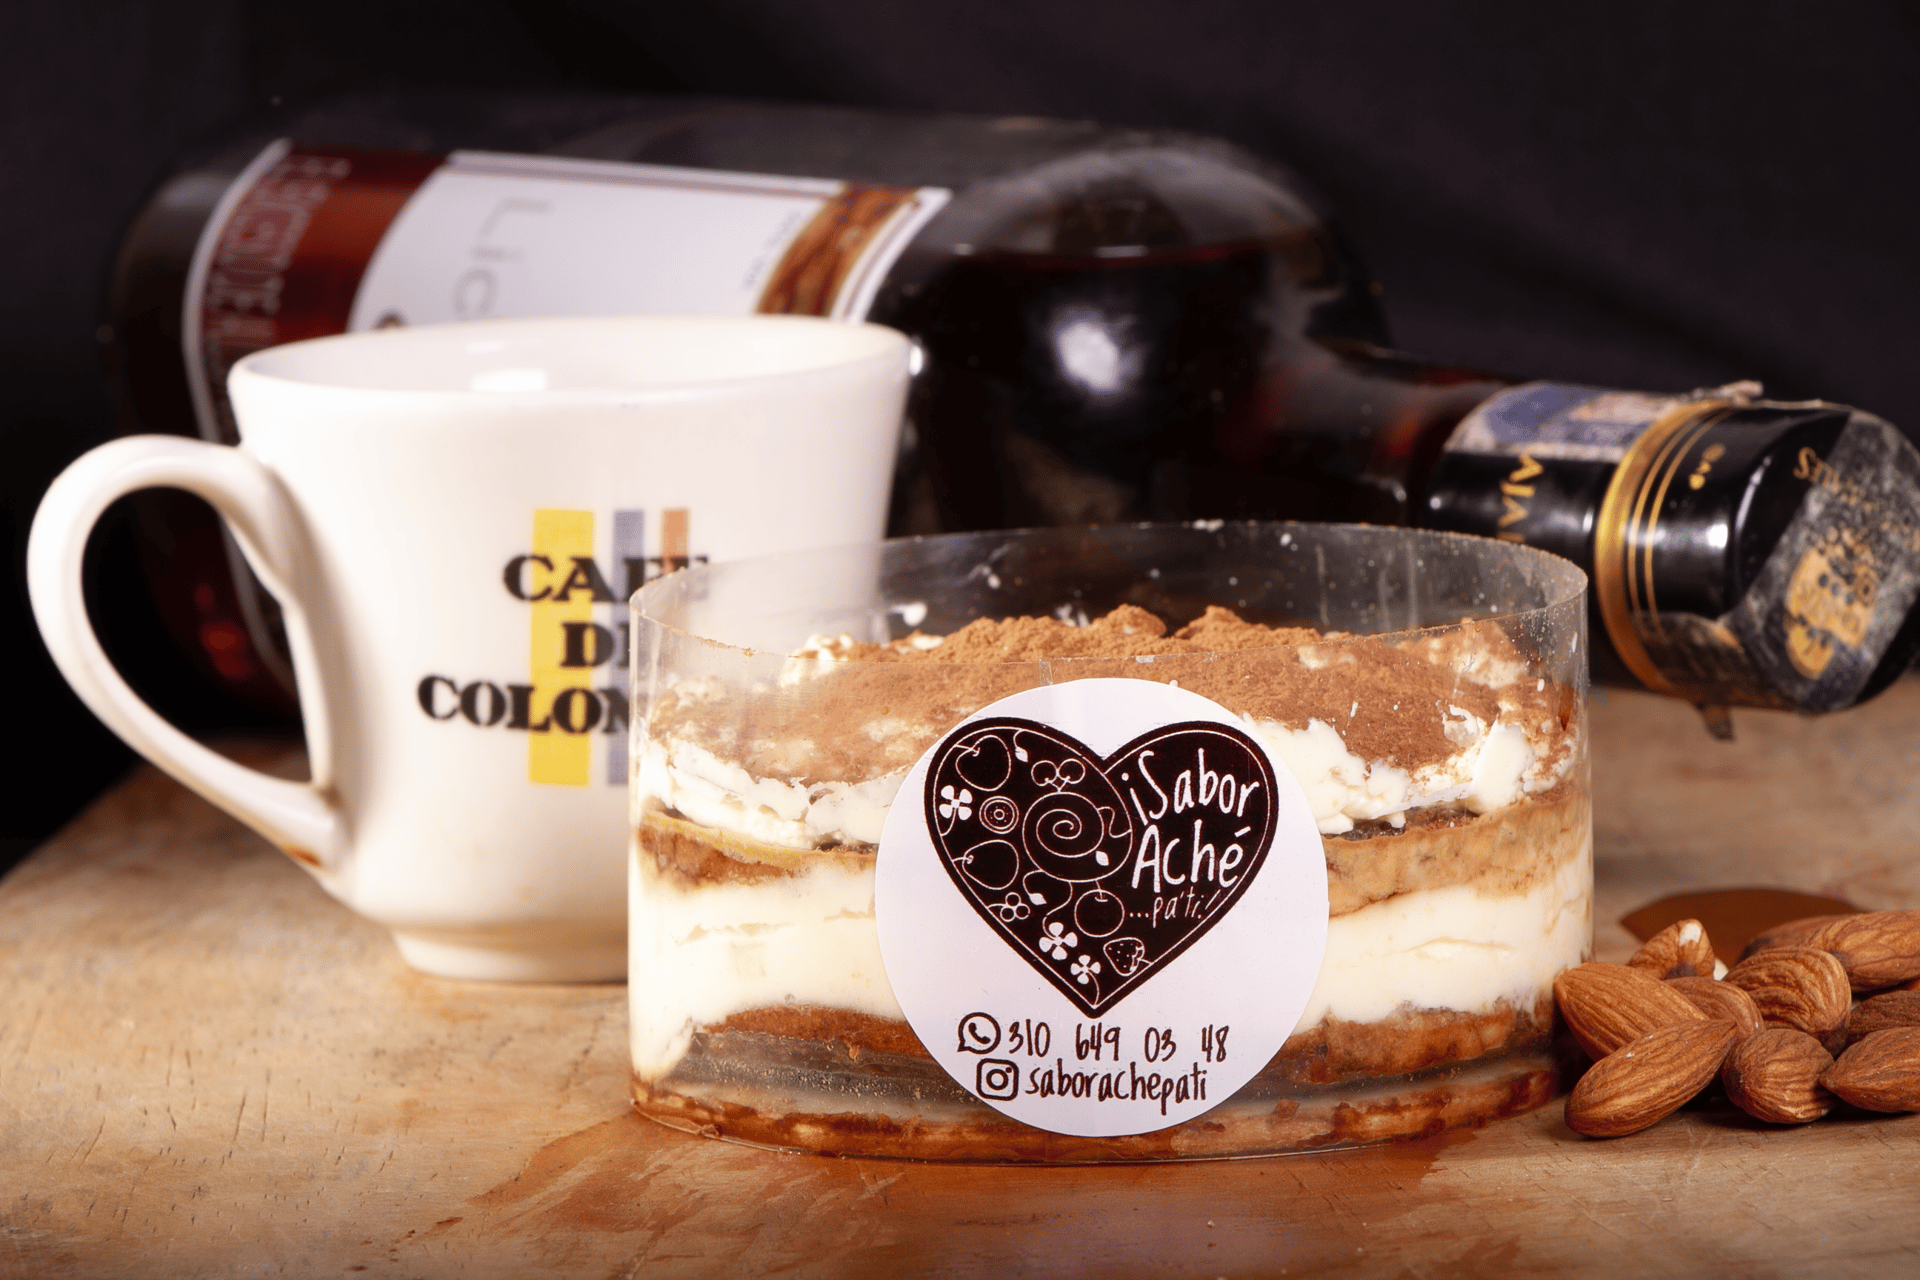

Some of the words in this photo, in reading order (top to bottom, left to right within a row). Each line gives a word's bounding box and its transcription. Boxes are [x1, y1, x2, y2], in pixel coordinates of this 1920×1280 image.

[558, 620, 631, 670] D
[1131, 819, 1251, 893] Aché
[1008, 1018, 1051, 1057] 310
[1075, 1022, 1121, 1061] 649
[1144, 1026, 1177, 1063] 03
[1201, 1024, 1230, 1063] 48
[1025, 1058, 1207, 1116] saborachepati
